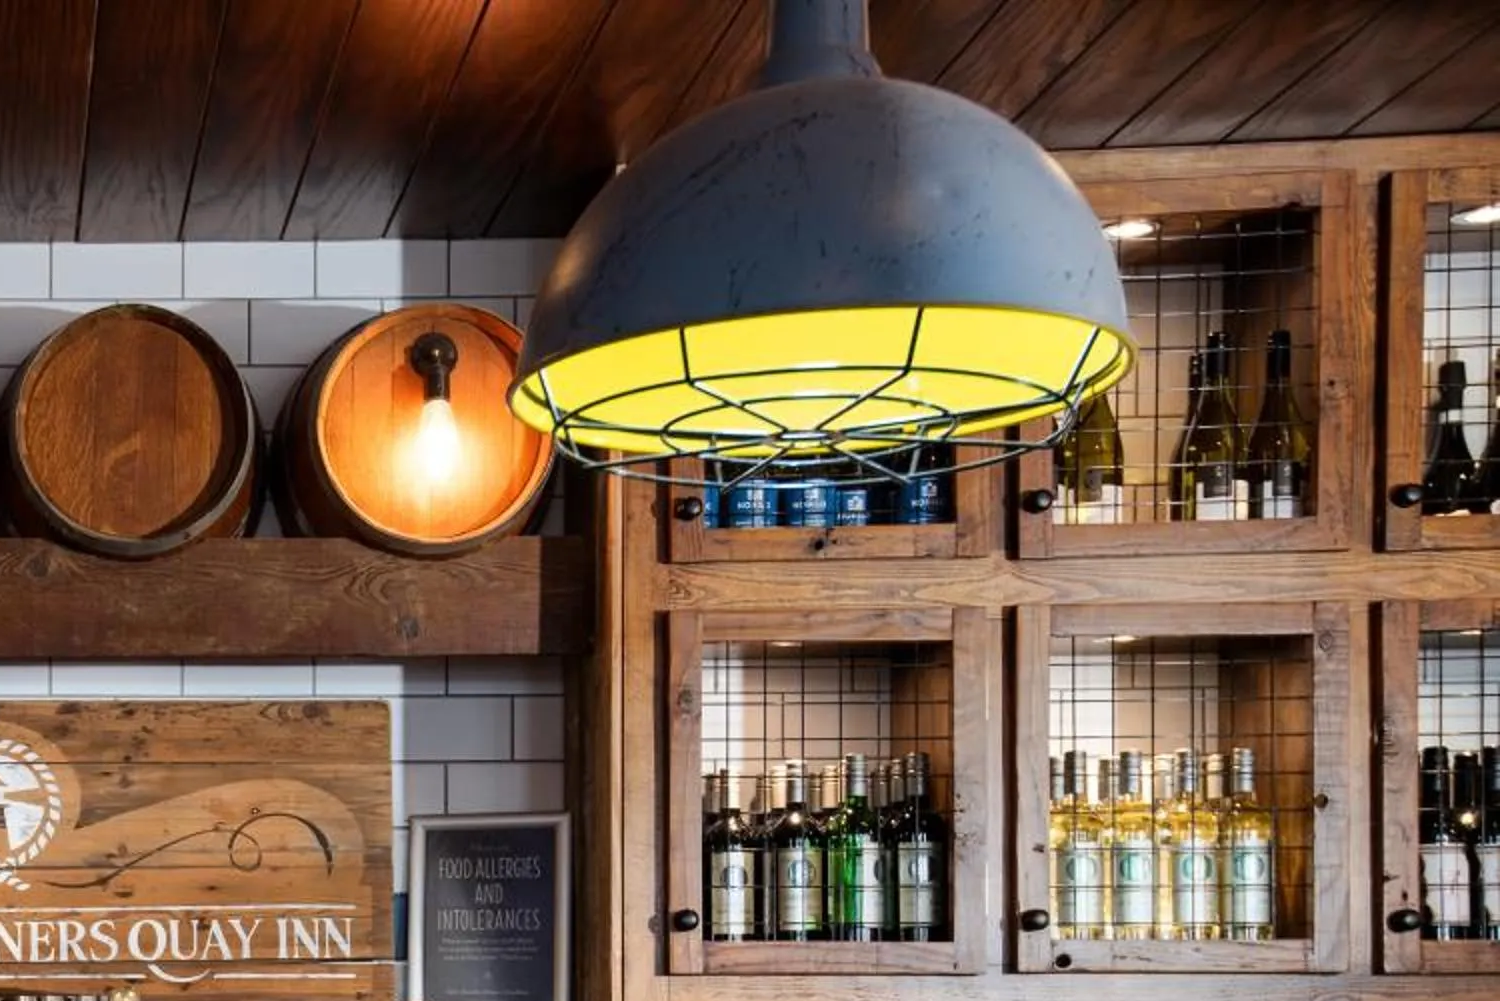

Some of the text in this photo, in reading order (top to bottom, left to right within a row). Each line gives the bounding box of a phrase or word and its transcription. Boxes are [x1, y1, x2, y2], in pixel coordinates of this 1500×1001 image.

[438, 856, 541, 880] FOOD ALLERGIES
[474, 882, 504, 905] AND
[436, 908, 541, 932] INTOLERANCES
[128, 917, 262, 978] QUAY
[275, 915, 354, 960] INN
